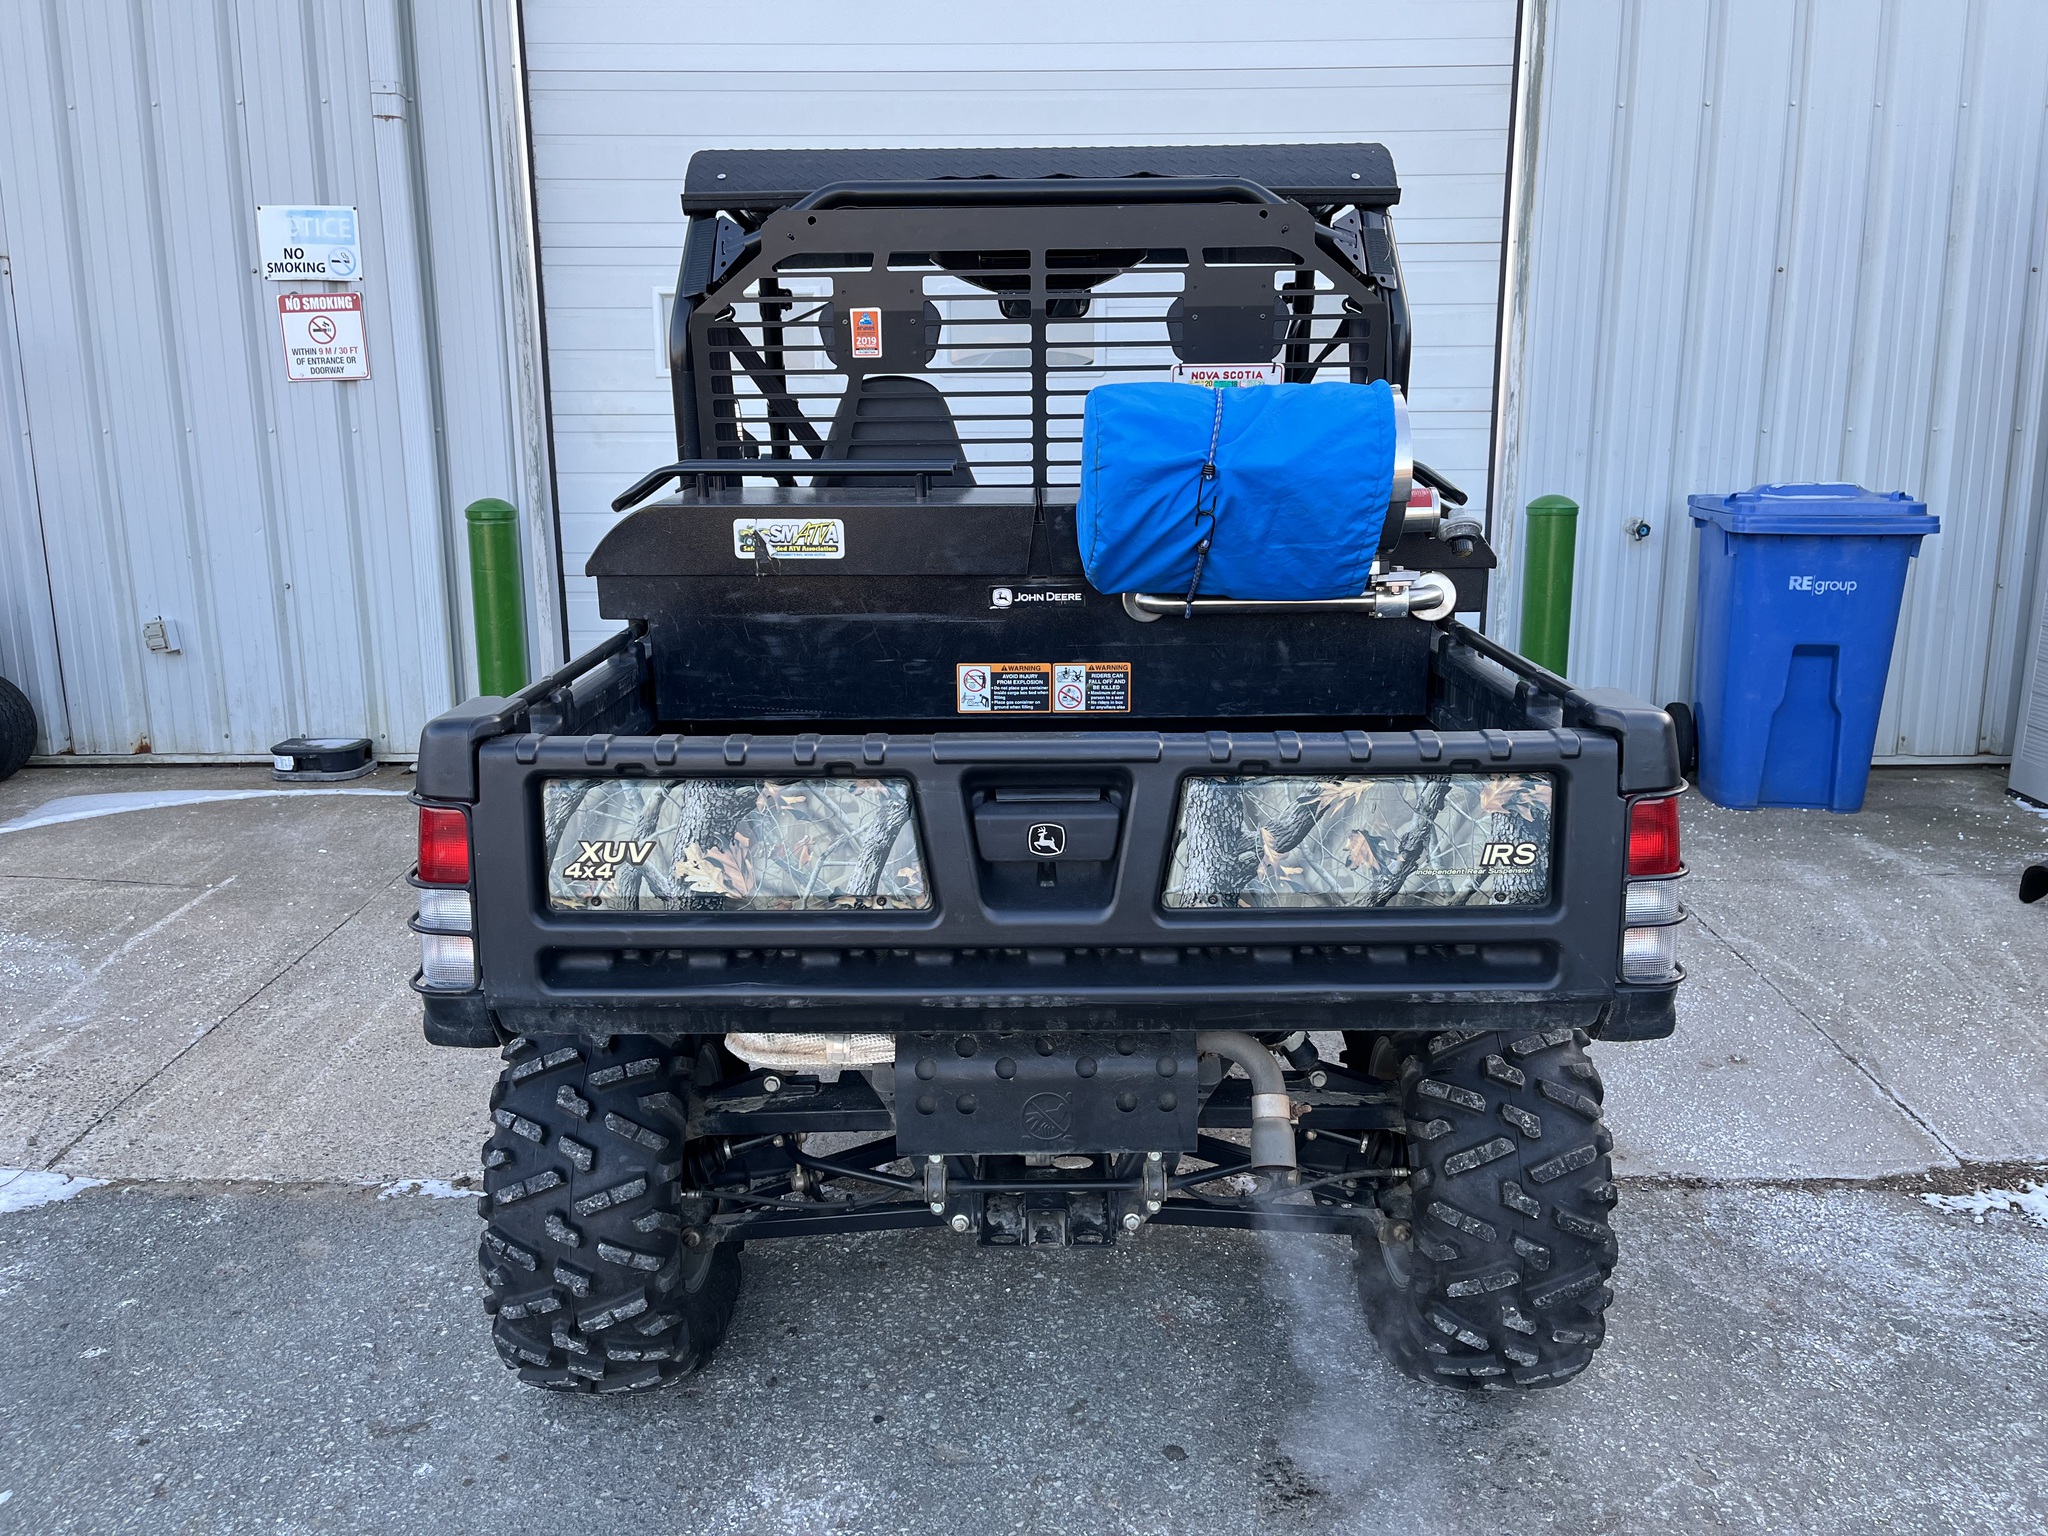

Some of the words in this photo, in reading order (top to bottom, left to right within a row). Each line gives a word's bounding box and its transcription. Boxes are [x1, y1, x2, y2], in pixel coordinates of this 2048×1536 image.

[283, 247, 304, 260] NO
[267, 262, 326, 274] SMOKING
[285, 296, 300, 310] NO
[302, 296, 353, 310] SMOKING
[856, 336, 876, 345] 2019
[291, 347, 317, 355] WITHIN
[307, 356, 344, 365] ENTRANCE
[310, 366, 344, 374] DOORWAY
[1191, 371, 1220, 380] NOVA
[1223, 371, 1263, 379] SCOTIA
[1014, 592, 1044, 602] JOHN
[1046, 592, 1082, 601] DEERE
[576, 841, 654, 864] XUV
[1481, 843, 1538, 866] IRS
[564, 862, 615, 879] 4x4
